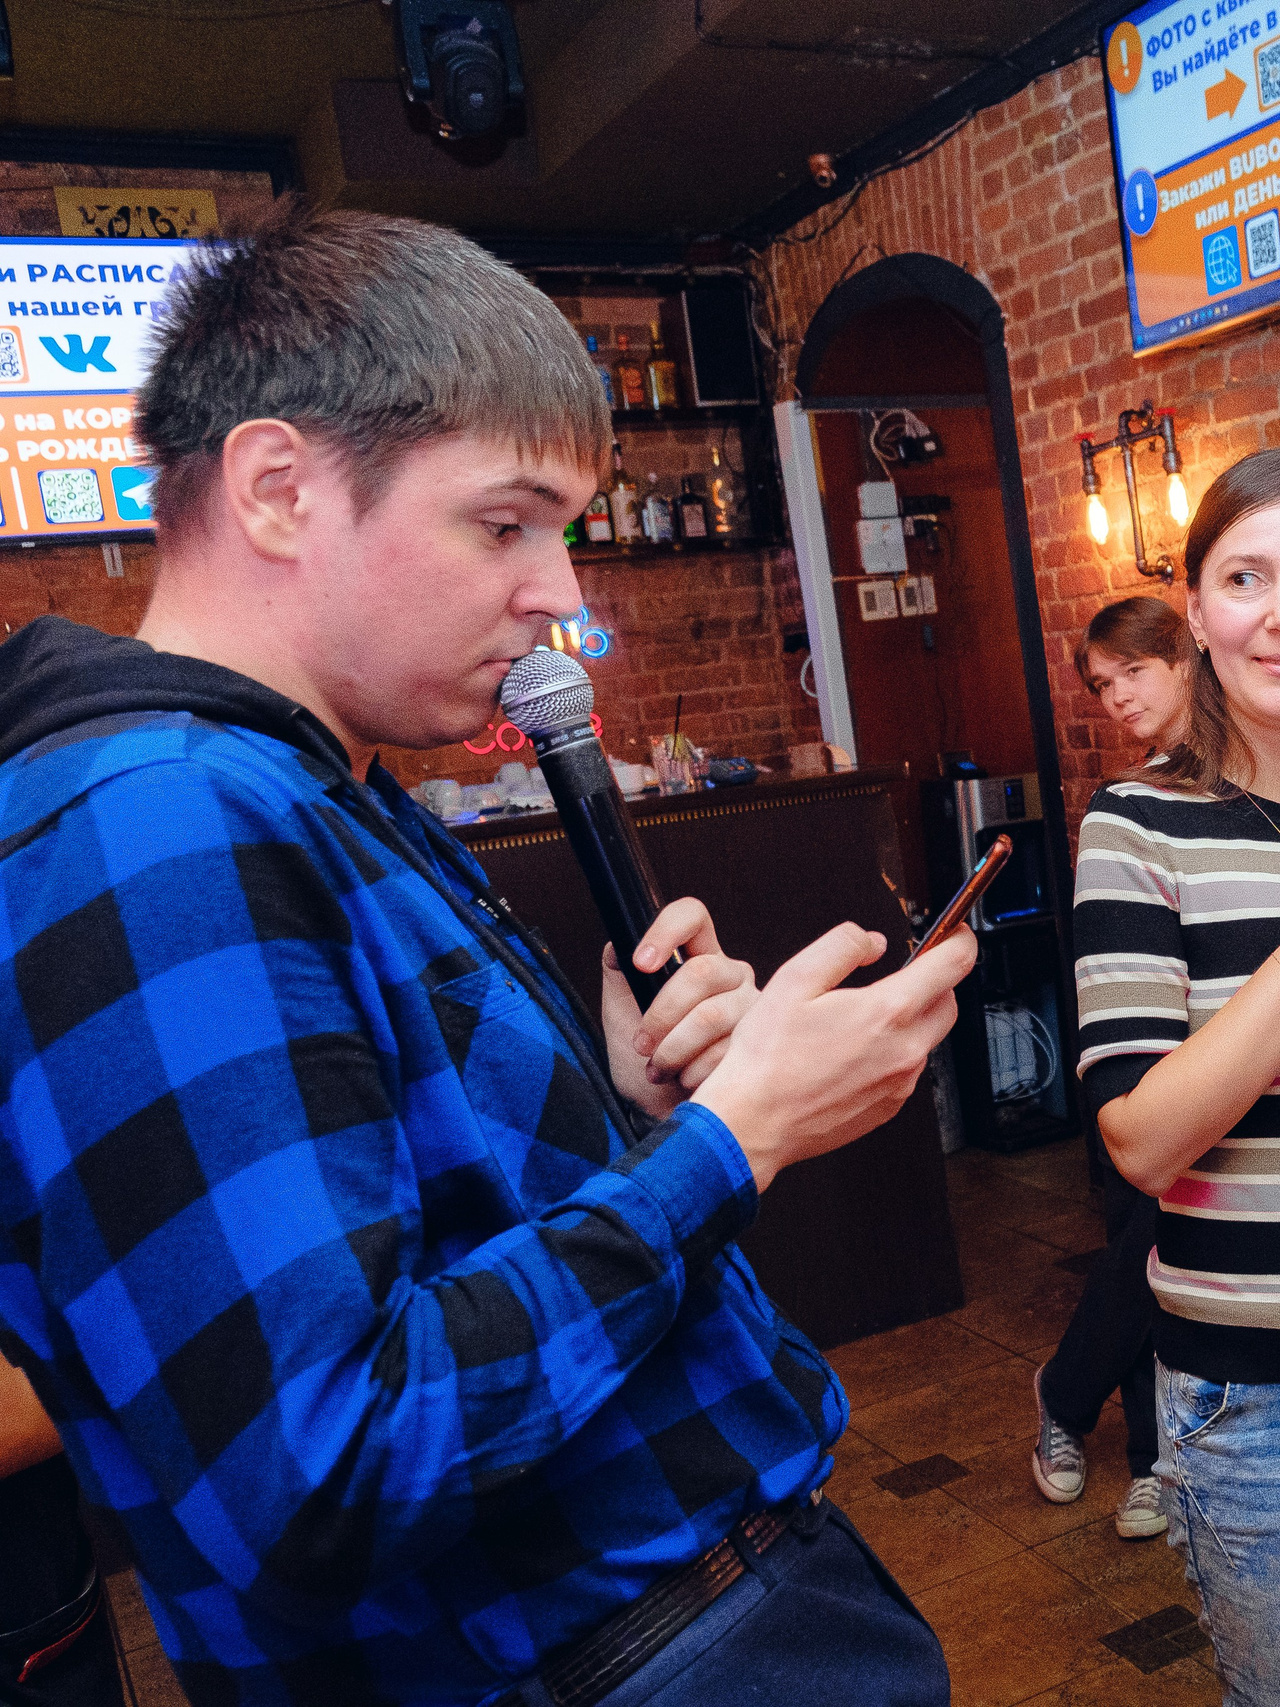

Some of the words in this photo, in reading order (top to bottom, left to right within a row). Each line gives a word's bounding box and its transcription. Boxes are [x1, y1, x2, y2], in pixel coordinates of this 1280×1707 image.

[1146, 14, 1196, 58] ФОТО
[1202, 9, 1211, 26] с
[1152, 63, 1178, 94] Вы
[1182, 20, 1260, 76] найдёте
[1266, 10, 1278, 30] в
[1159, 168, 1226, 213] Закажи
[1195, 200, 1230, 230] или
[27, 264, 188, 283] РАСПИСА
[8, 295, 123, 316] нашей
[134, 301, 171, 323] гр
[14, 413, 56, 431] на
[62, 407, 135, 430] КОР
